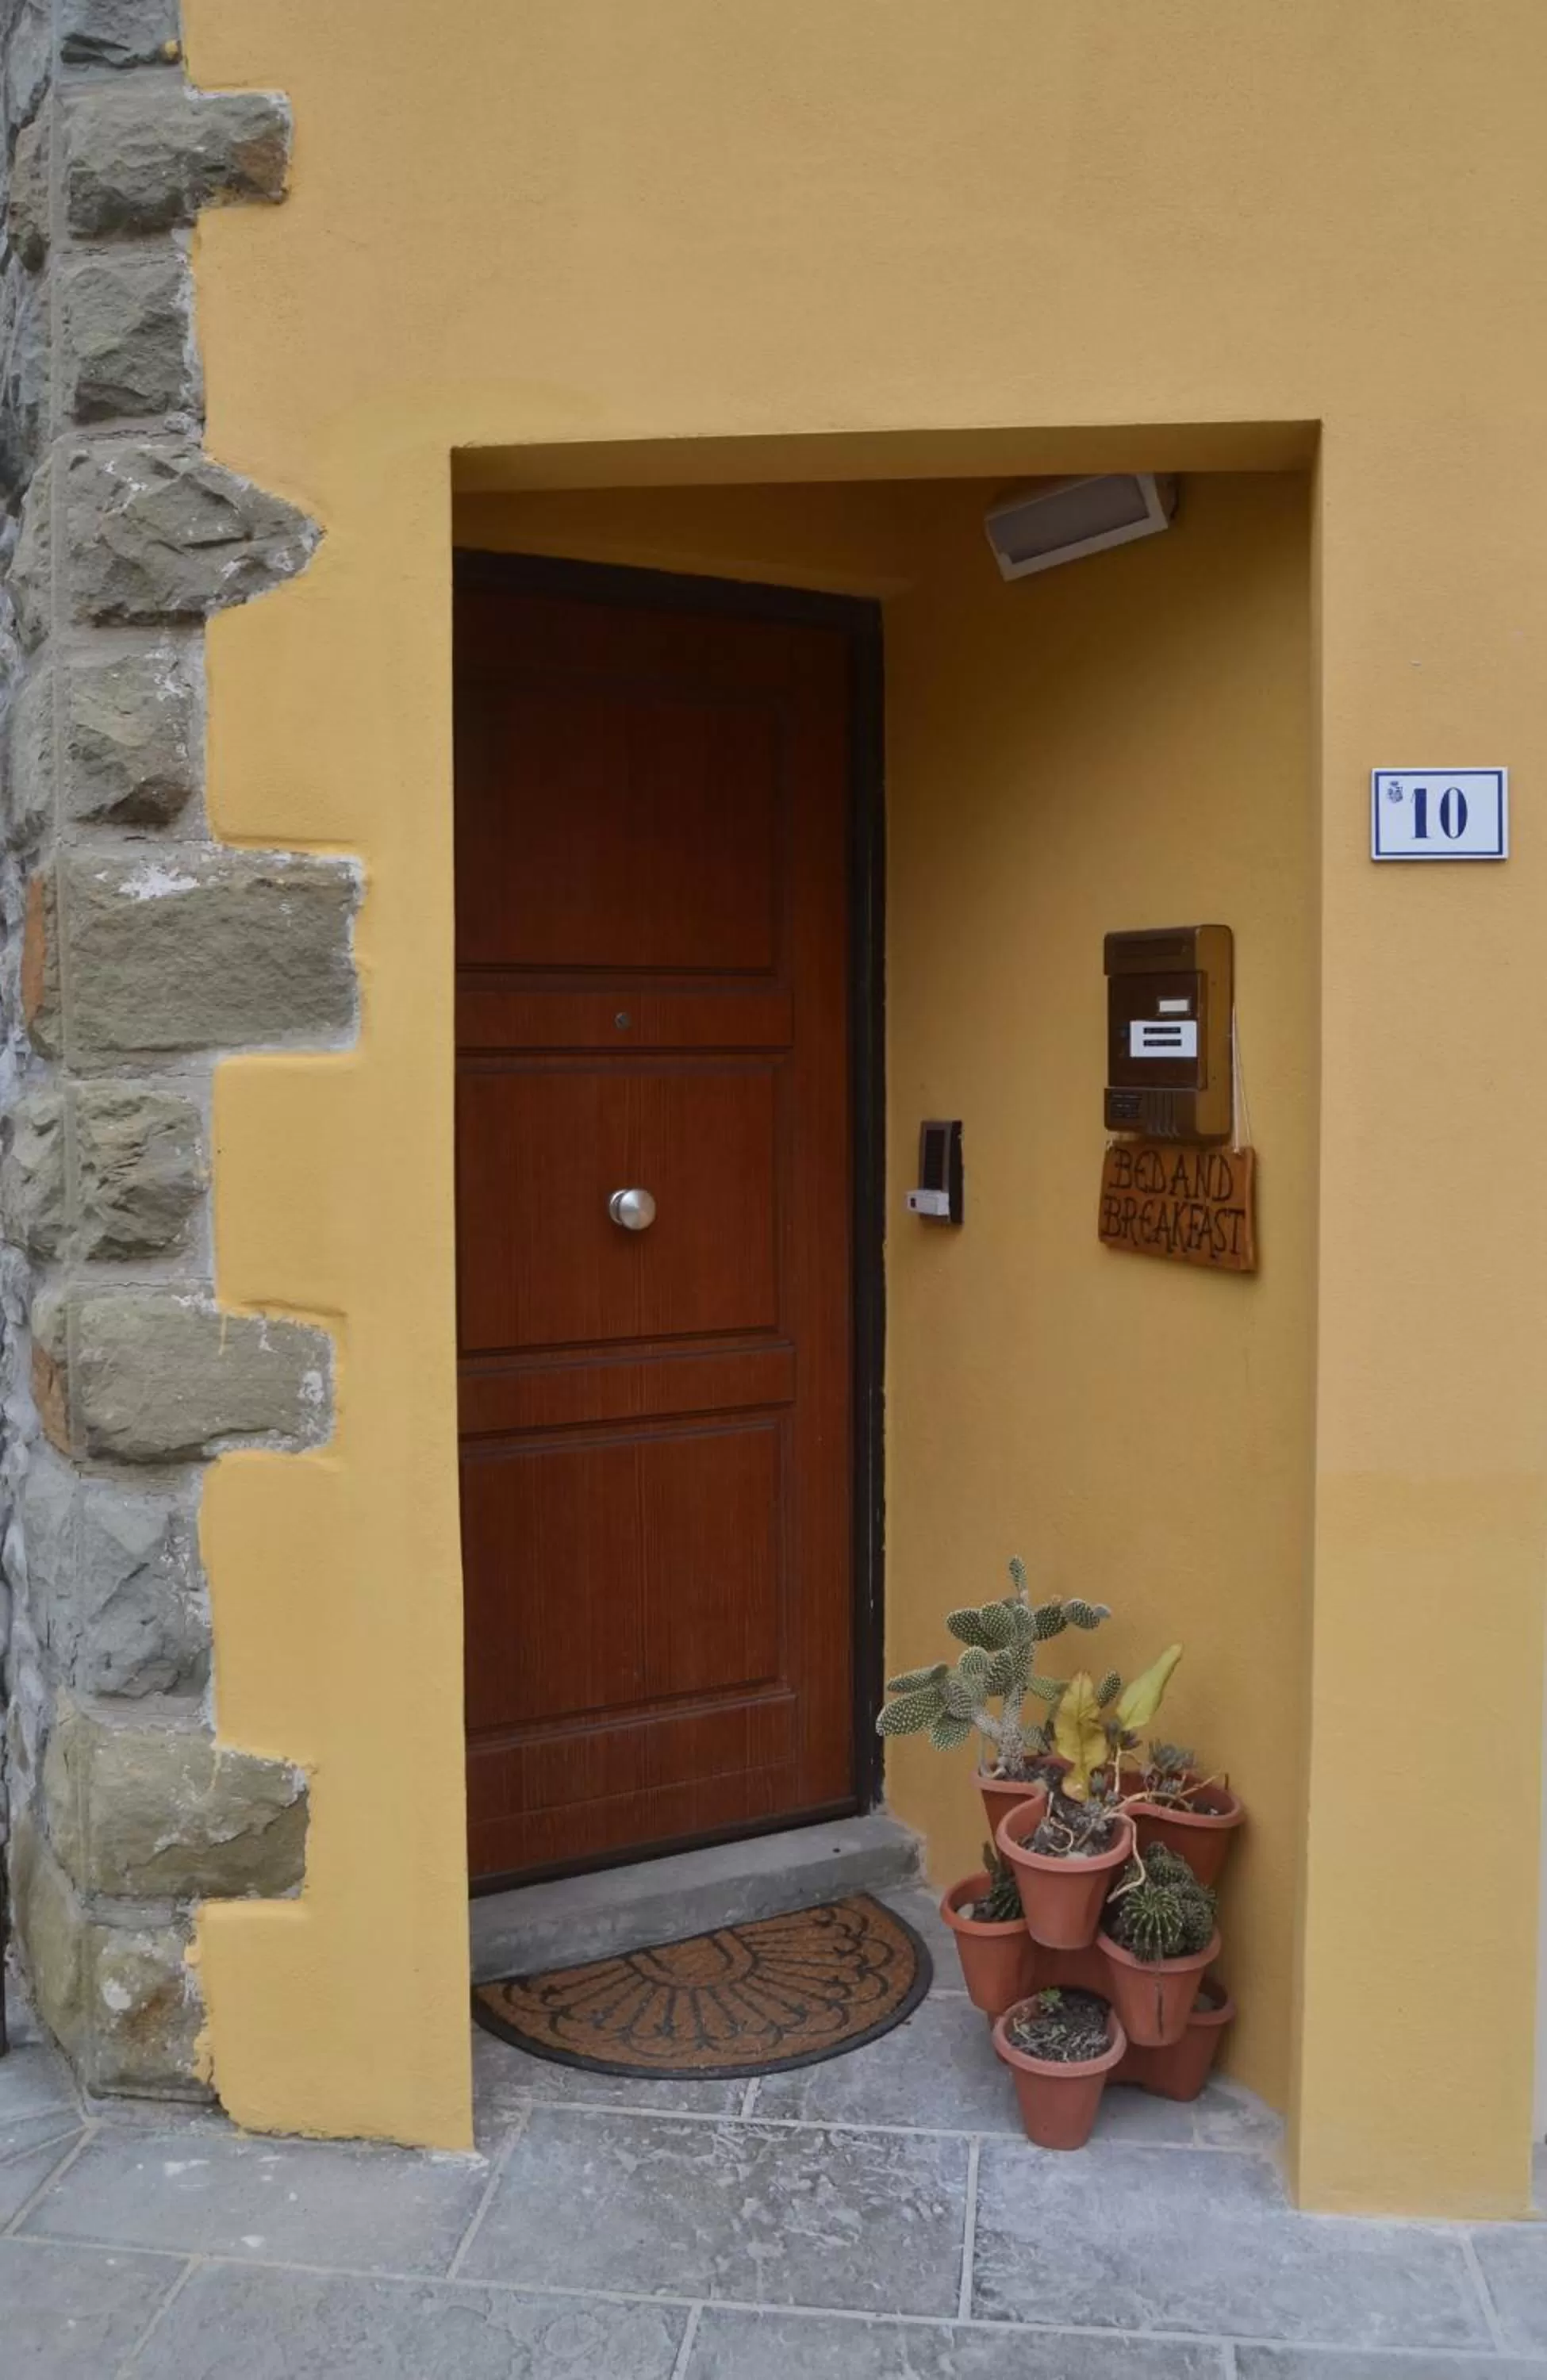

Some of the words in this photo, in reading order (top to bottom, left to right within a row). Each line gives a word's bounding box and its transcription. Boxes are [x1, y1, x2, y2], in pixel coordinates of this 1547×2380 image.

[1411, 786, 1468, 839] 10
[1109, 1149, 1166, 1194] BED
[1169, 1154, 1234, 1202] AND
[1104, 1195, 1246, 1258] BREAKFAST
